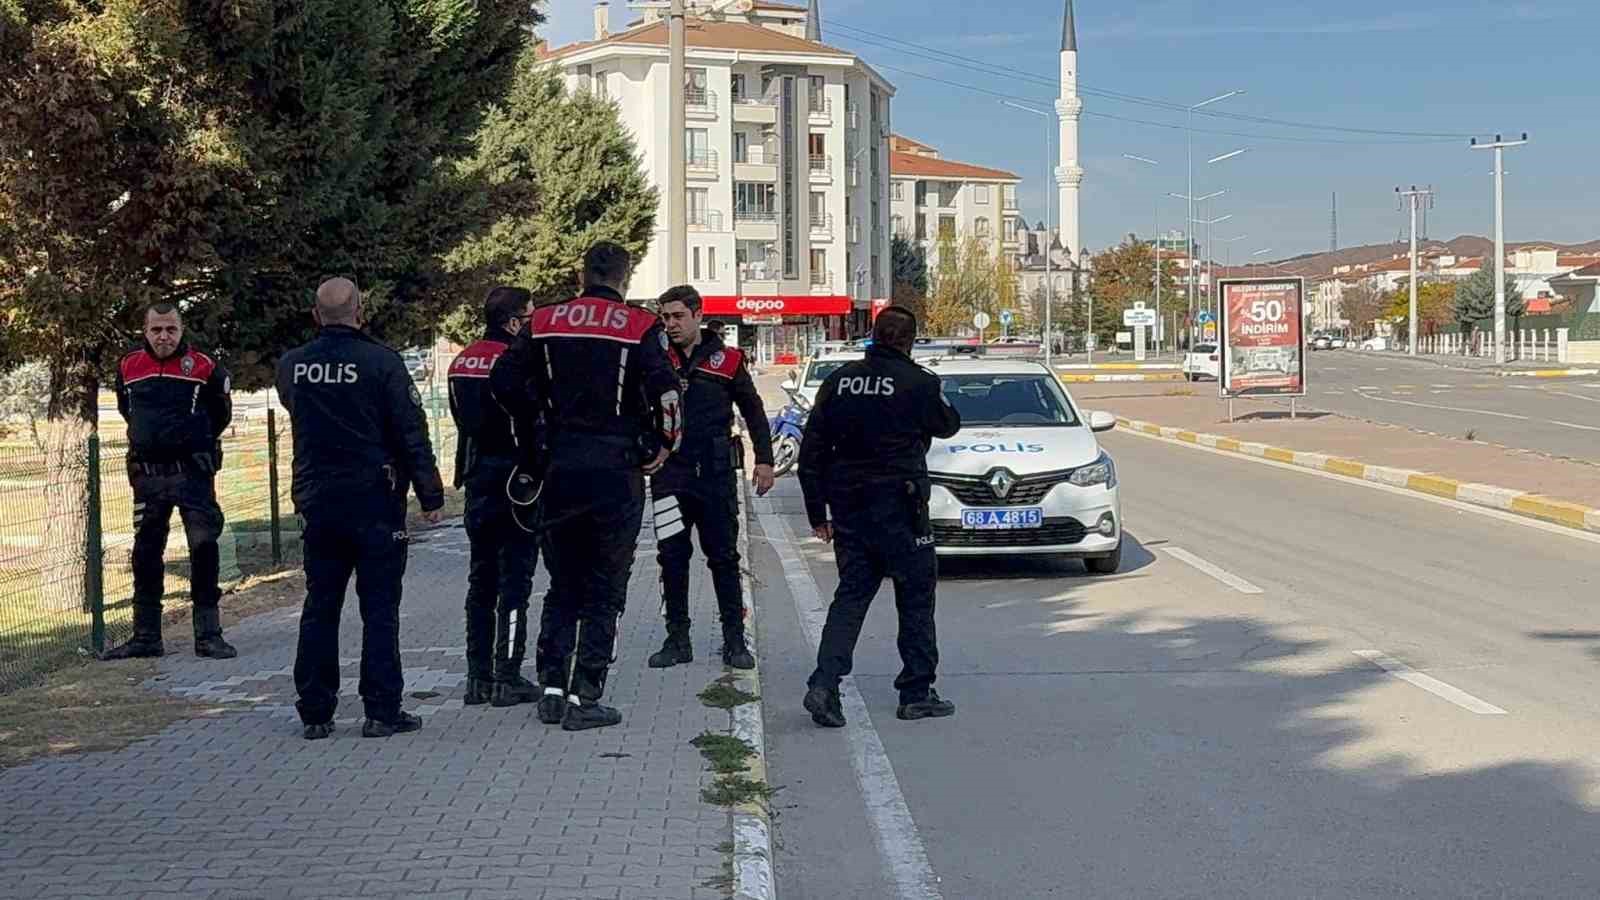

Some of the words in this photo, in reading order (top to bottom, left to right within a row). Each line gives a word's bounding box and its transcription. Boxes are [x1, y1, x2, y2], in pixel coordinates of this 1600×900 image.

[736, 297, 785, 312] depoo
[967, 511, 985, 524] 68
[988, 511, 1000, 525] A
[1002, 510, 1038, 524] 4815
